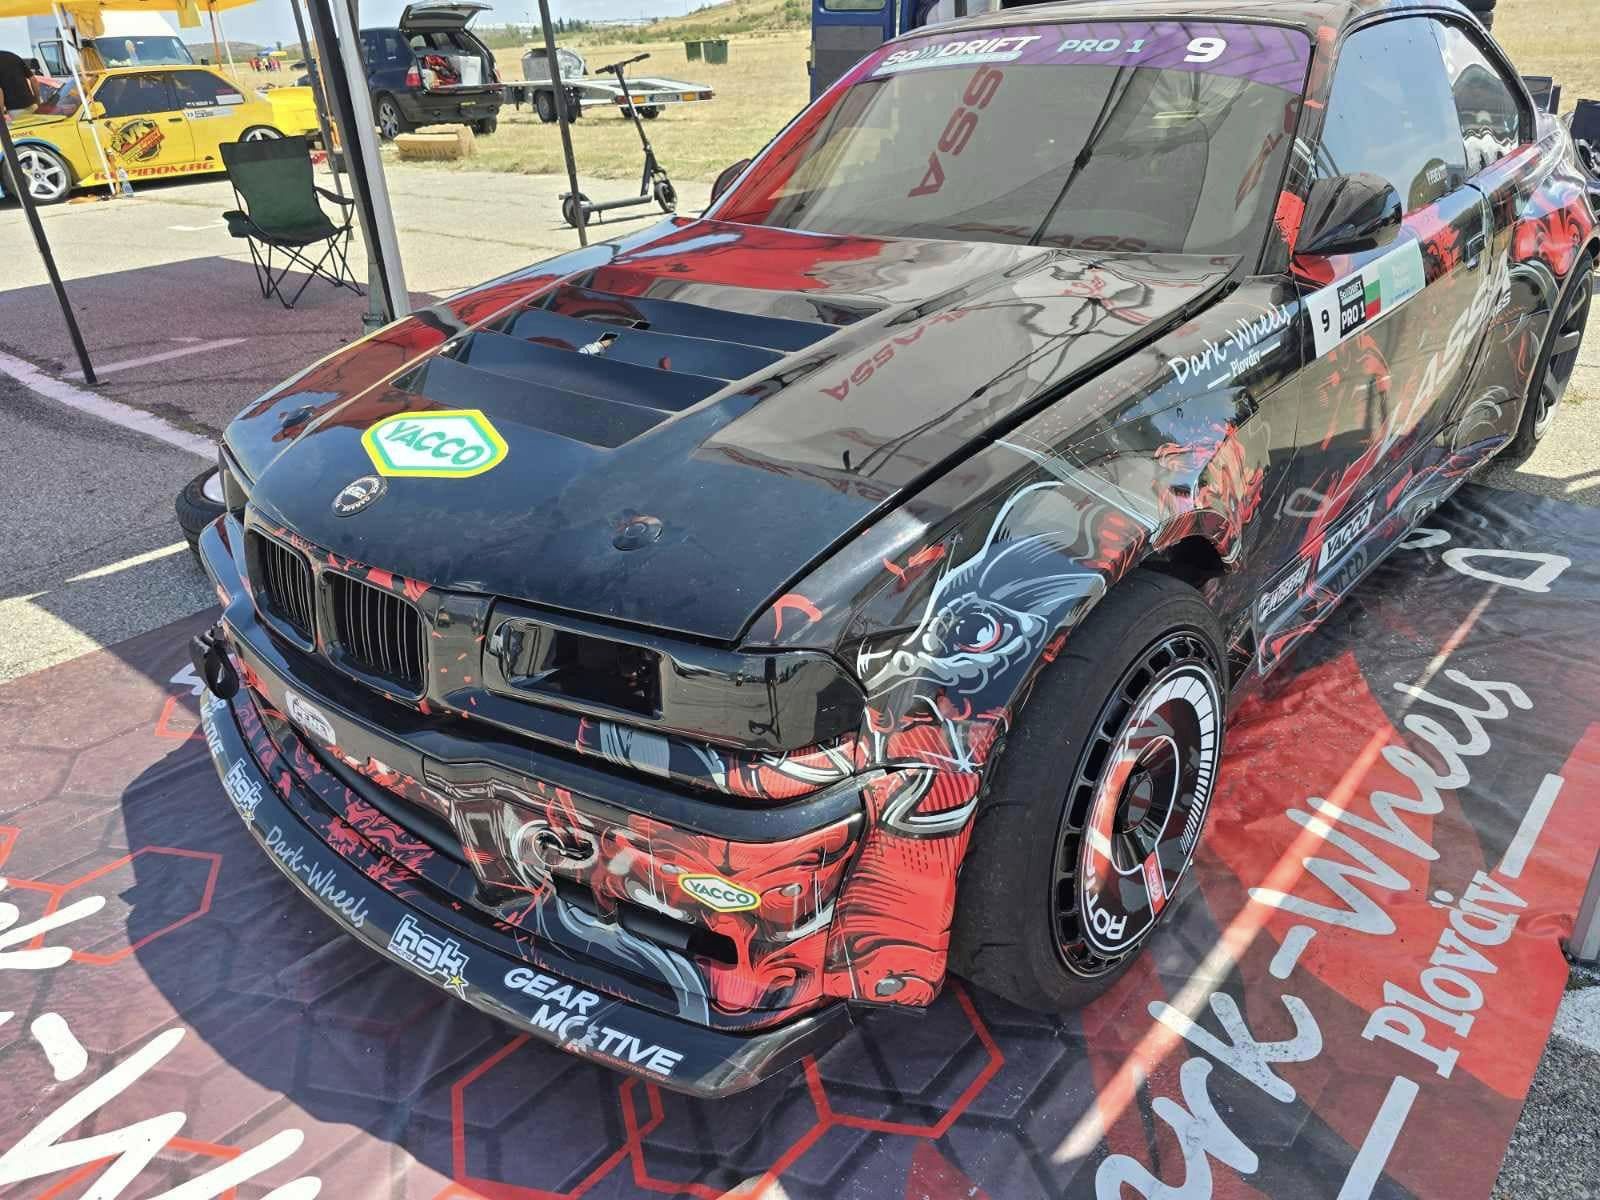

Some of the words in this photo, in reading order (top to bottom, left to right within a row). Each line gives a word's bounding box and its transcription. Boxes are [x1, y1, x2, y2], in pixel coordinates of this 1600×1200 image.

[1056, 39, 1121, 53] PRO
[1126, 39, 1145, 53] 1
[1183, 37, 1227, 62] 9
[1321, 309, 1331, 333] 9
[1341, 304, 1359, 330] PRO
[1360, 301, 1366, 317] 1
[1167, 302, 1292, 385] Dark-Wheels
[1230, 348, 1262, 378] Plovdiv
[385, 421, 485, 466] YACCO
[1327, 507, 1369, 561] YACCO
[264, 825, 369, 928] Dark-Wheels
[689, 879, 750, 905] YACCO
[503, 967, 601, 1014] GEAR
[1361, 869, 1529, 1079] Plovdiv
[529, 1003, 684, 1076] MOTIVE
